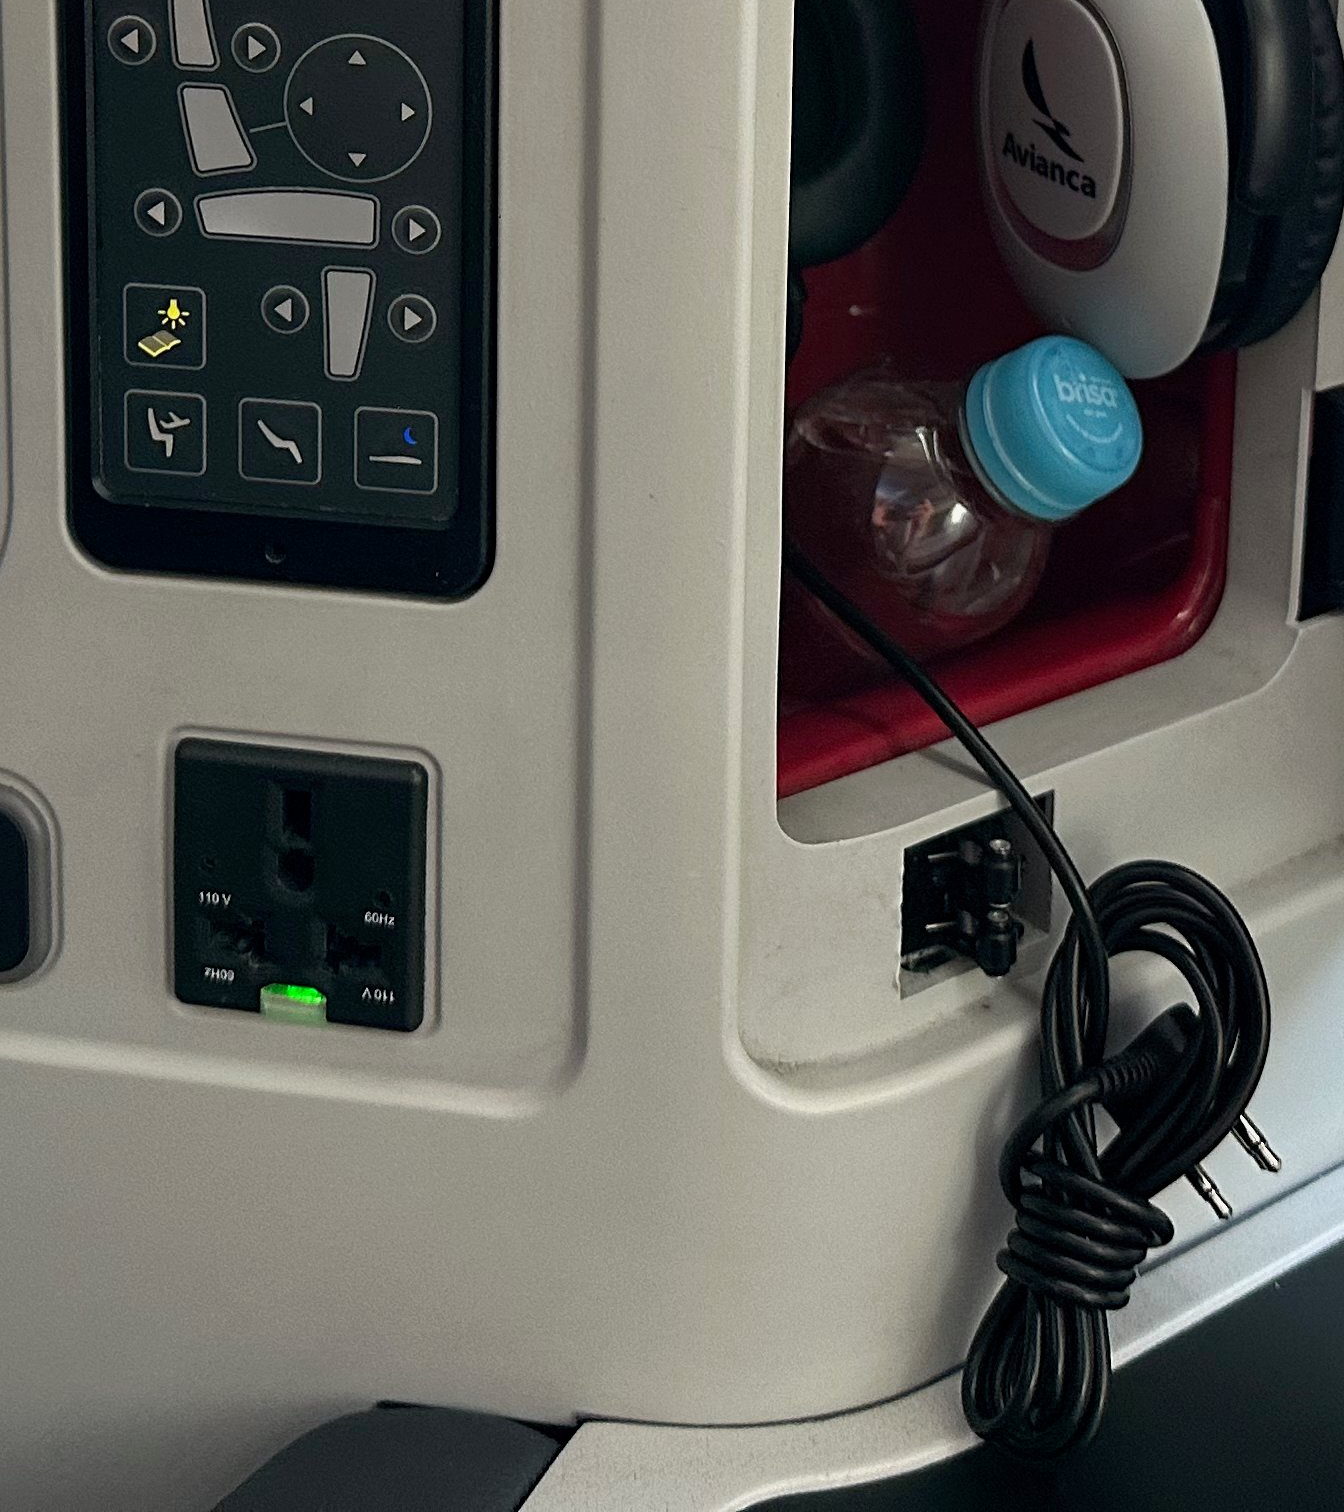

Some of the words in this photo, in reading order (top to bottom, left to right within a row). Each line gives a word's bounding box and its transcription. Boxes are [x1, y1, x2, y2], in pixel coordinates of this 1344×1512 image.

[1001, 131, 1098, 199] Avianca
[1053, 372, 1119, 409] brisa
[198, 890, 220, 905] 110
[221, 893, 232, 907] V
[363, 910, 396, 927] 60Hz
[361, 986, 372, 1001] V
